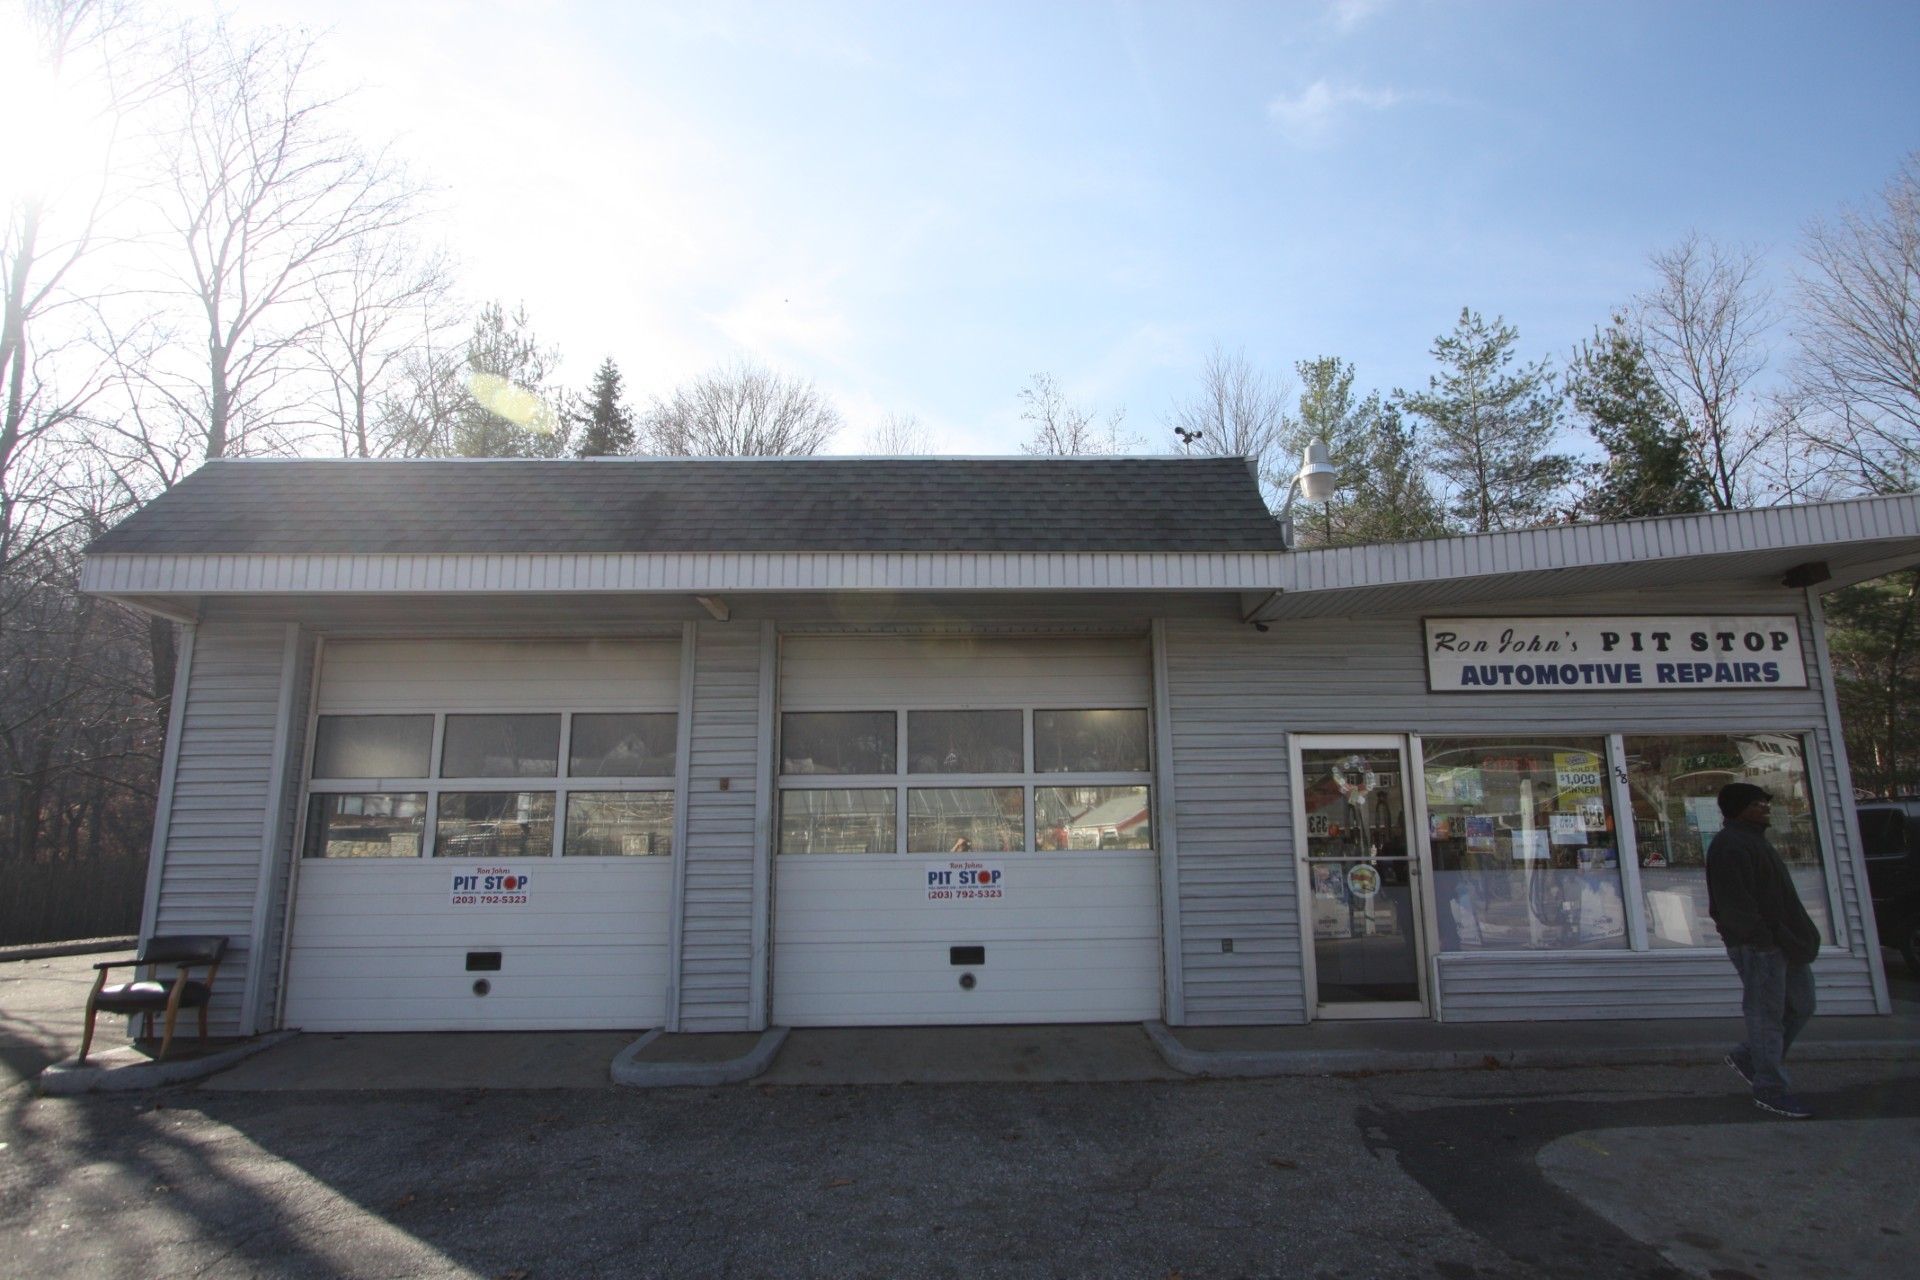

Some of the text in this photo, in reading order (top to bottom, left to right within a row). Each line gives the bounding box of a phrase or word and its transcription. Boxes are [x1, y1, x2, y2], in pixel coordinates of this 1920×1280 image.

[1434, 628, 1789, 654] Ron John's PIT STOP
[1461, 661, 1780, 686] AUTOMOTIVE REPAIRS
[1560, 774, 1596, 785] $1,000
[453, 875, 528, 890] PIT STOP
[928, 870, 1001, 885] PIT STOP
[452, 895, 527, 905] (203) 792-5323
[928, 890, 1002, 900] (203) 792-5323
